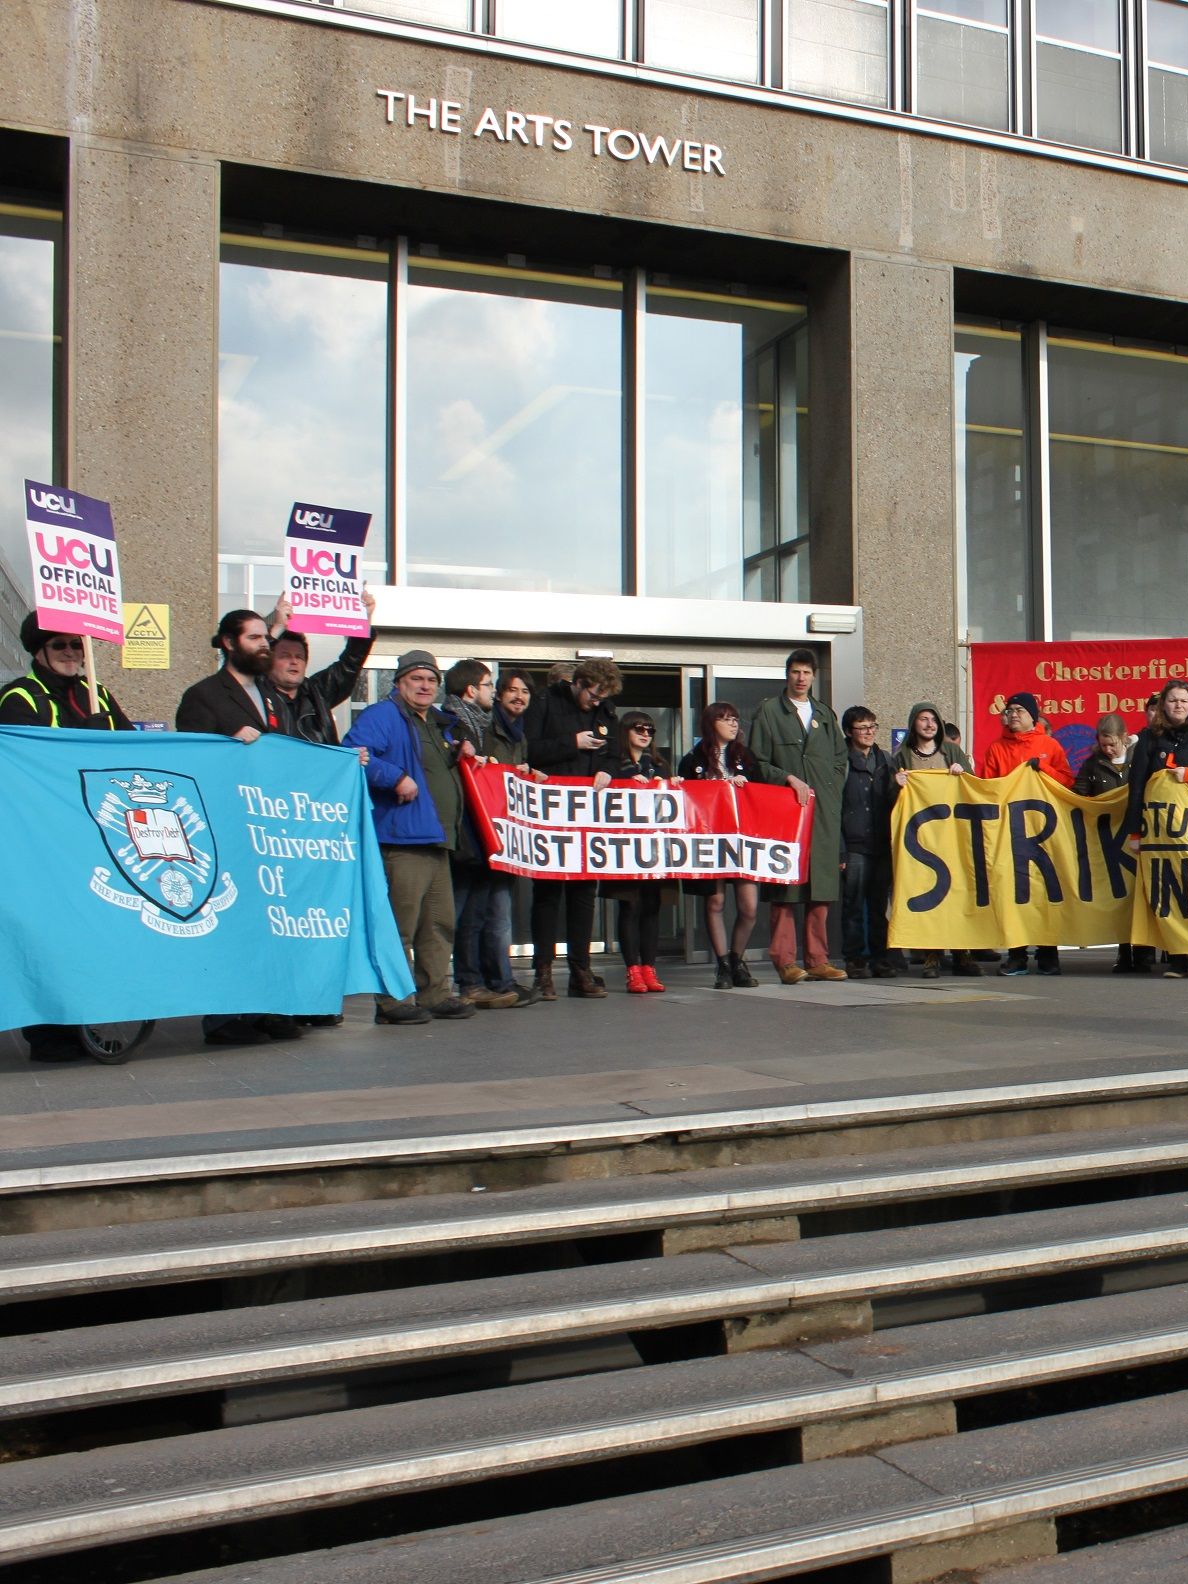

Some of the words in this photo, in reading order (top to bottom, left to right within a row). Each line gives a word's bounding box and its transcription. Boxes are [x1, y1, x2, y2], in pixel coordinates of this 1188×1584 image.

[377, 89, 461, 133] THE
[474, 107, 572, 151] ARTS
[585, 124, 726, 175] TOWER
[36, 532, 114, 577] UCU
[290, 546, 357, 580] UCU
[40, 565, 116, 595] OFFICIAL
[291, 576, 359, 595] OFFICIAL
[42, 583, 118, 614] DISPUTE
[291, 592, 362, 612] DISPUTE
[238, 785, 289, 819] The
[290, 792, 349, 823] Free
[507, 777, 679, 824] SHEFFIELD
[132, 826, 164, 840] Destroy
[164, 826, 179, 838] Debt
[589, 836, 793, 875] STUDENTS
[92, 880, 111, 898] THE
[113, 893, 139, 908] FREE
[258, 865, 287, 897] Of
[147, 915, 205, 935] UNIVERSITY
[206, 916, 215, 928] OF
